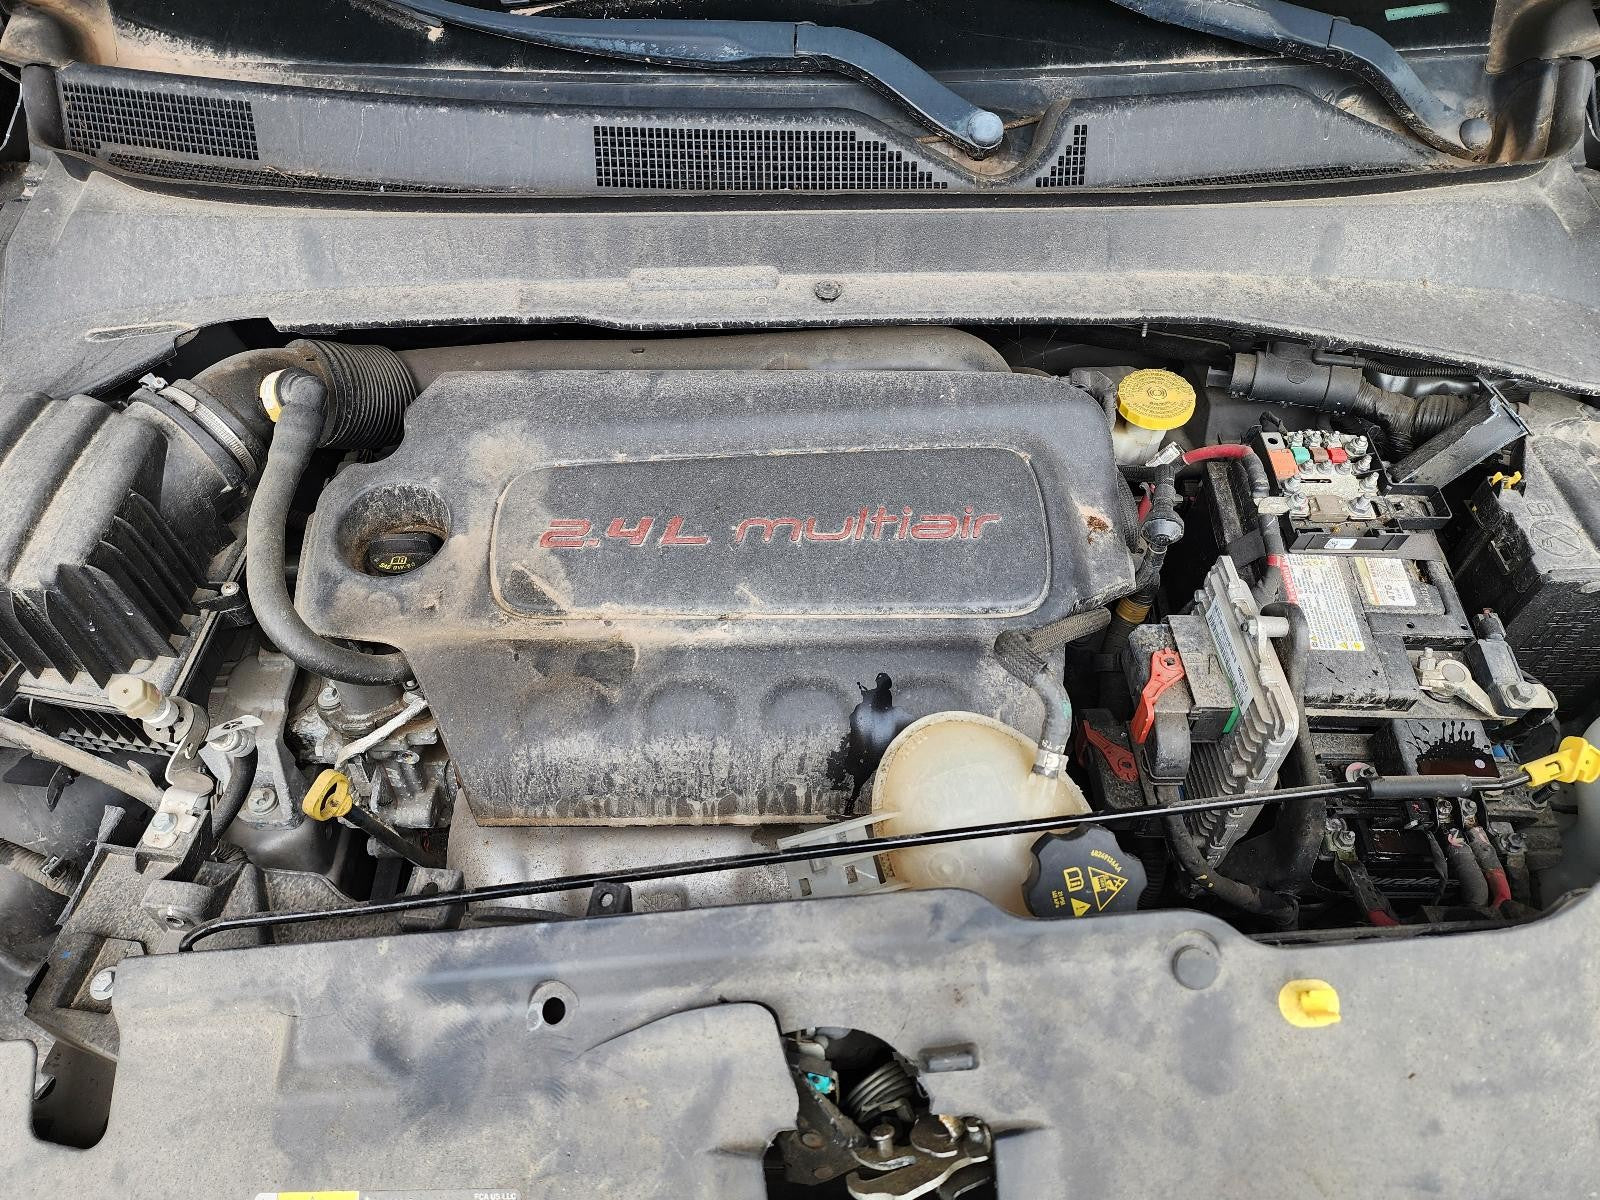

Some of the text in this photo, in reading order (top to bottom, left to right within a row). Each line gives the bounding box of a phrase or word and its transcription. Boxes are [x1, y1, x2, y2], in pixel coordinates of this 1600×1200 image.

[734, 505, 1001, 543] multiair
[474, 1192, 516, 1200] FCA US LLC
